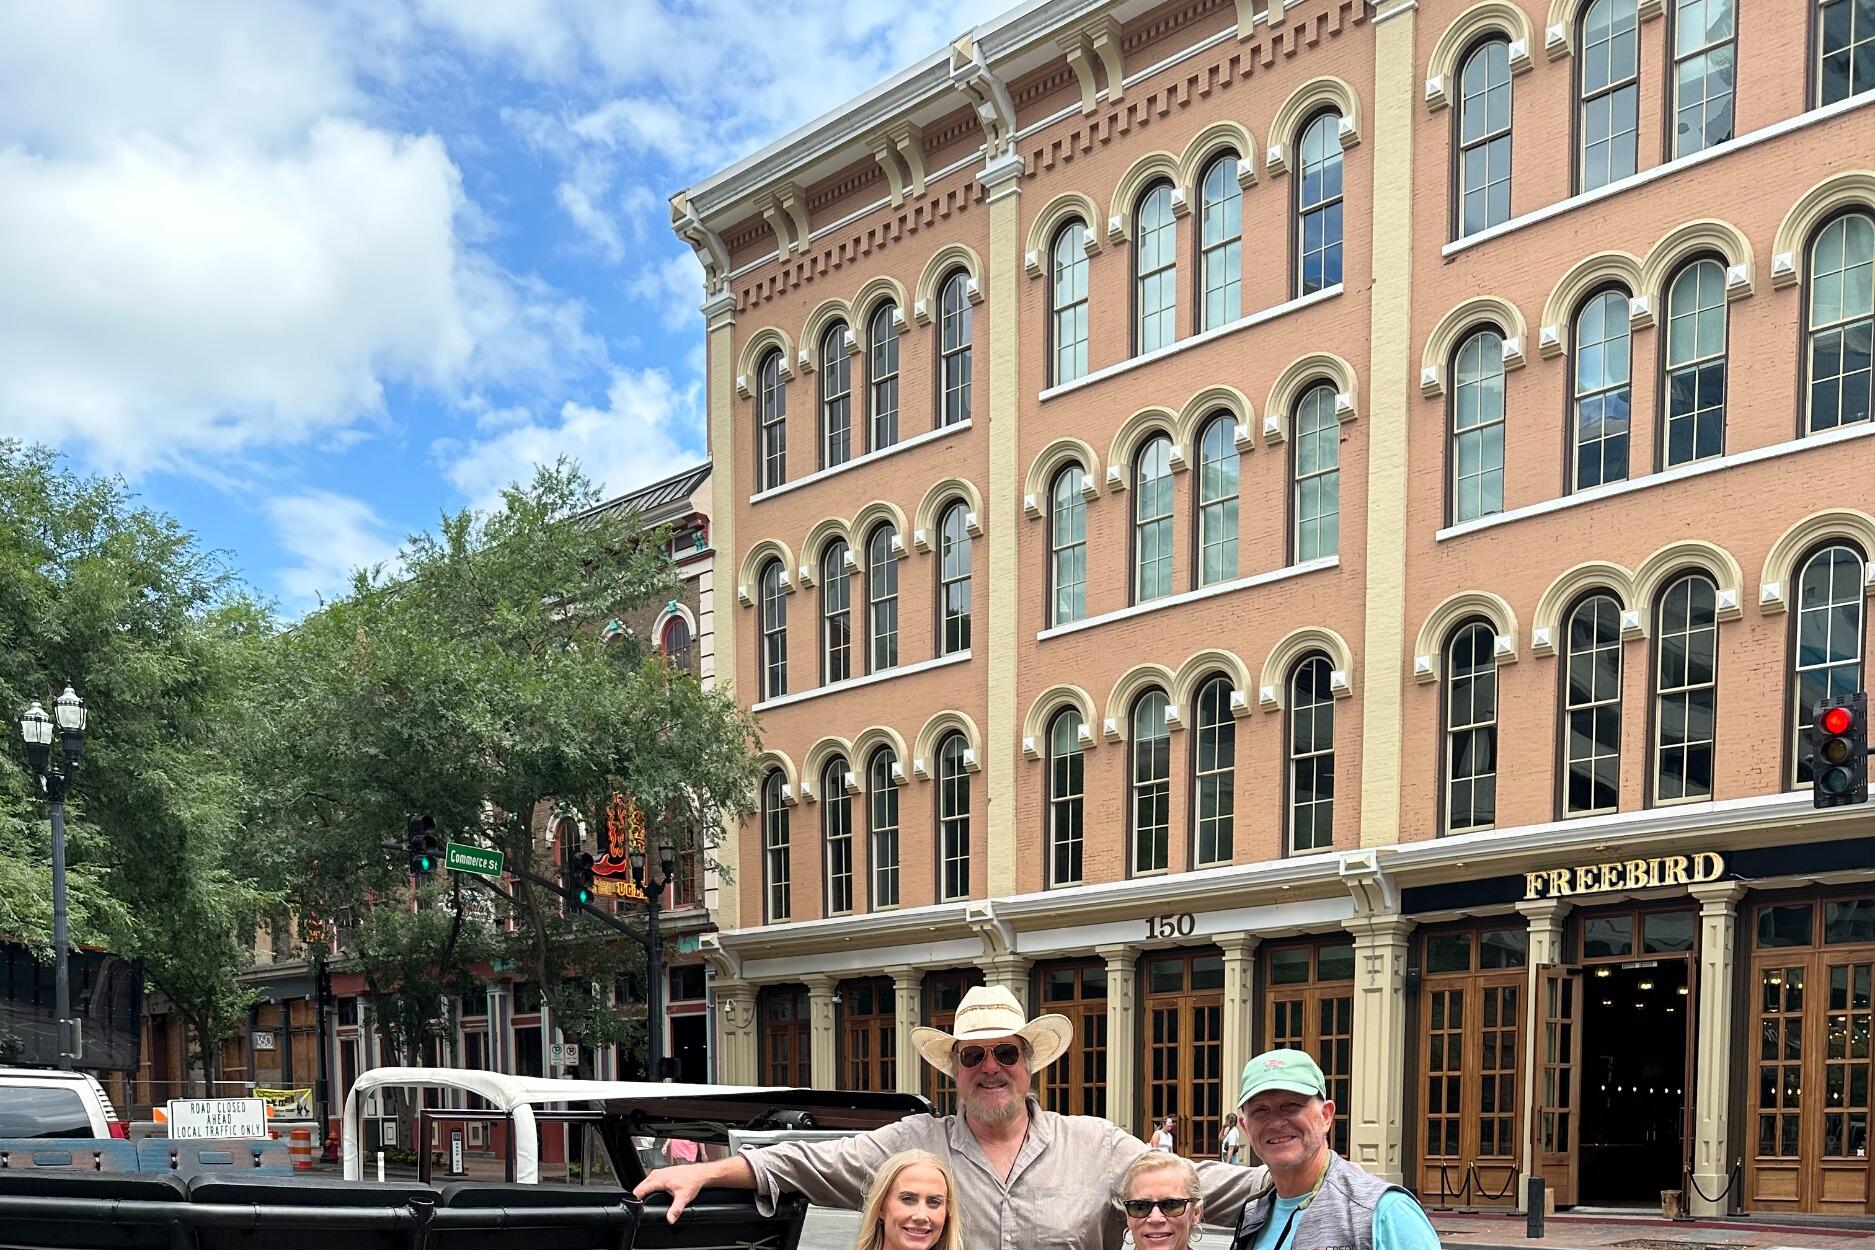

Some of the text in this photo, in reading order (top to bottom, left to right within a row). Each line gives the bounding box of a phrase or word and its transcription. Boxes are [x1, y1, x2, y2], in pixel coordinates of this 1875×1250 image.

[450, 849, 498, 871] Commerce St
[1523, 851, 1725, 900] FREEBIRD
[617, 881, 648, 900] UGL
[1145, 912, 1196, 940] 150
[190, 1101, 246, 1114] ROAD CLOSED
[206, 1113, 232, 1125] AHEAD
[177, 1124, 260, 1138] LOCAL TRAFFIC ONLY
